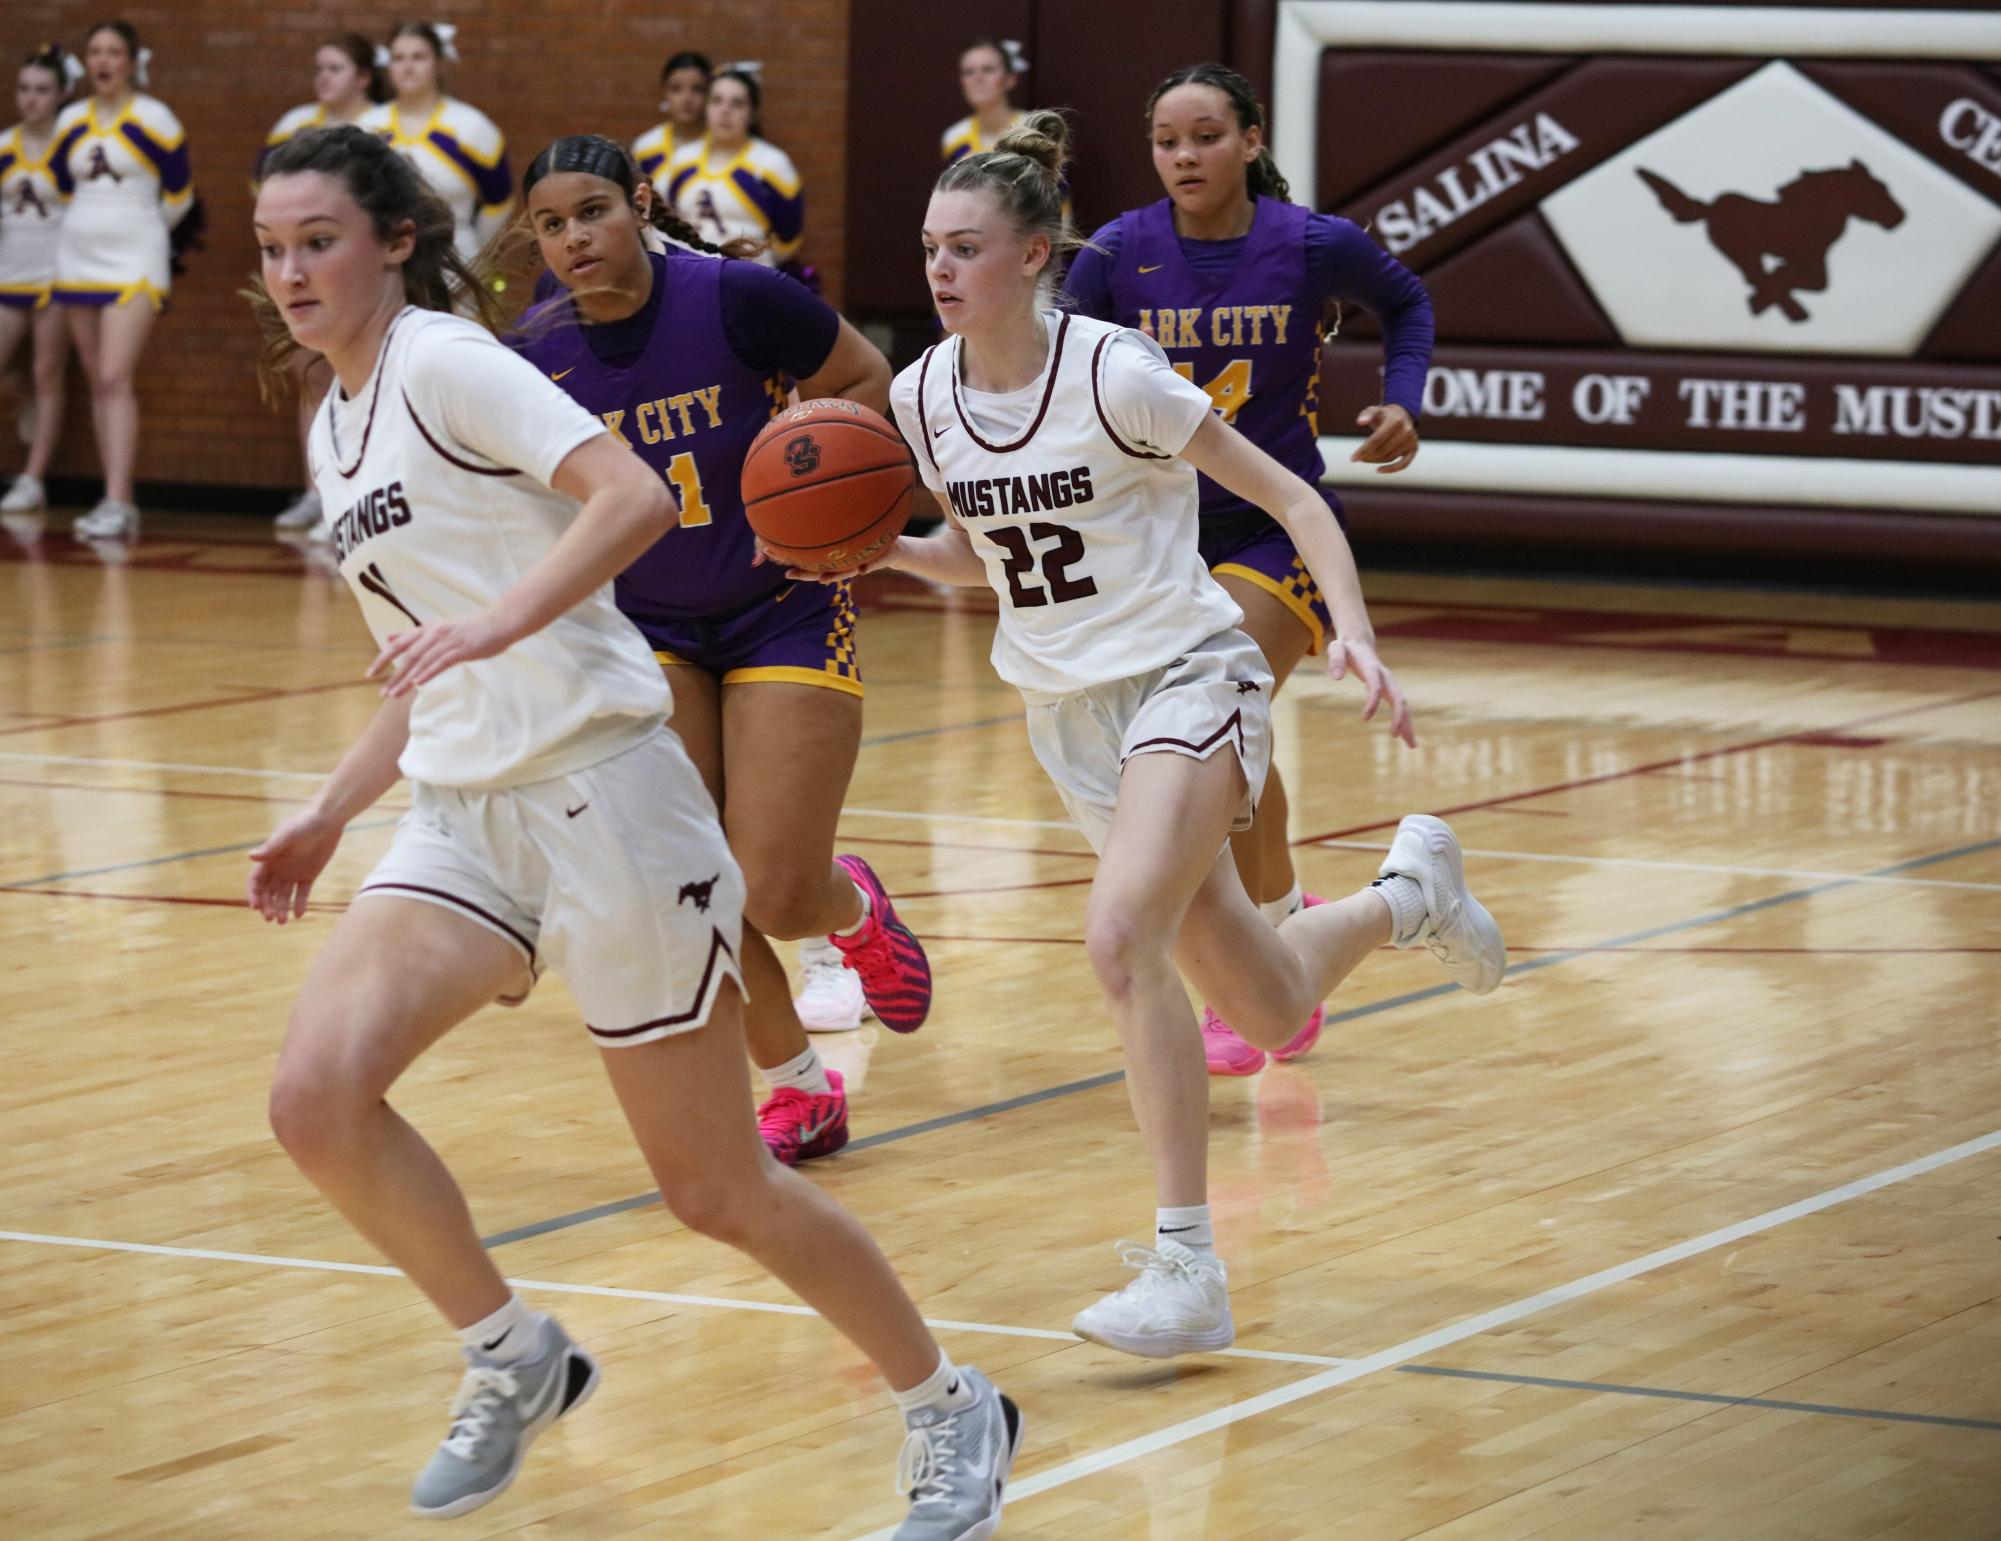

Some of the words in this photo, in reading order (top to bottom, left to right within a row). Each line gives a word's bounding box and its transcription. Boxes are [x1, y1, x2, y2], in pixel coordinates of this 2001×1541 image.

[1375, 111, 1581, 256] SALINA
[1210, 304, 1293, 347] CITY
[635, 384, 723, 445] CITY
[1378, 364, 1546, 421] OME
[1572, 373, 1650, 426] OF
[1677, 377, 1807, 433] THE
[665, 450, 713, 529] 1
[946, 466, 1095, 518] MUSTANGS
[983, 521, 1099, 609] 22
